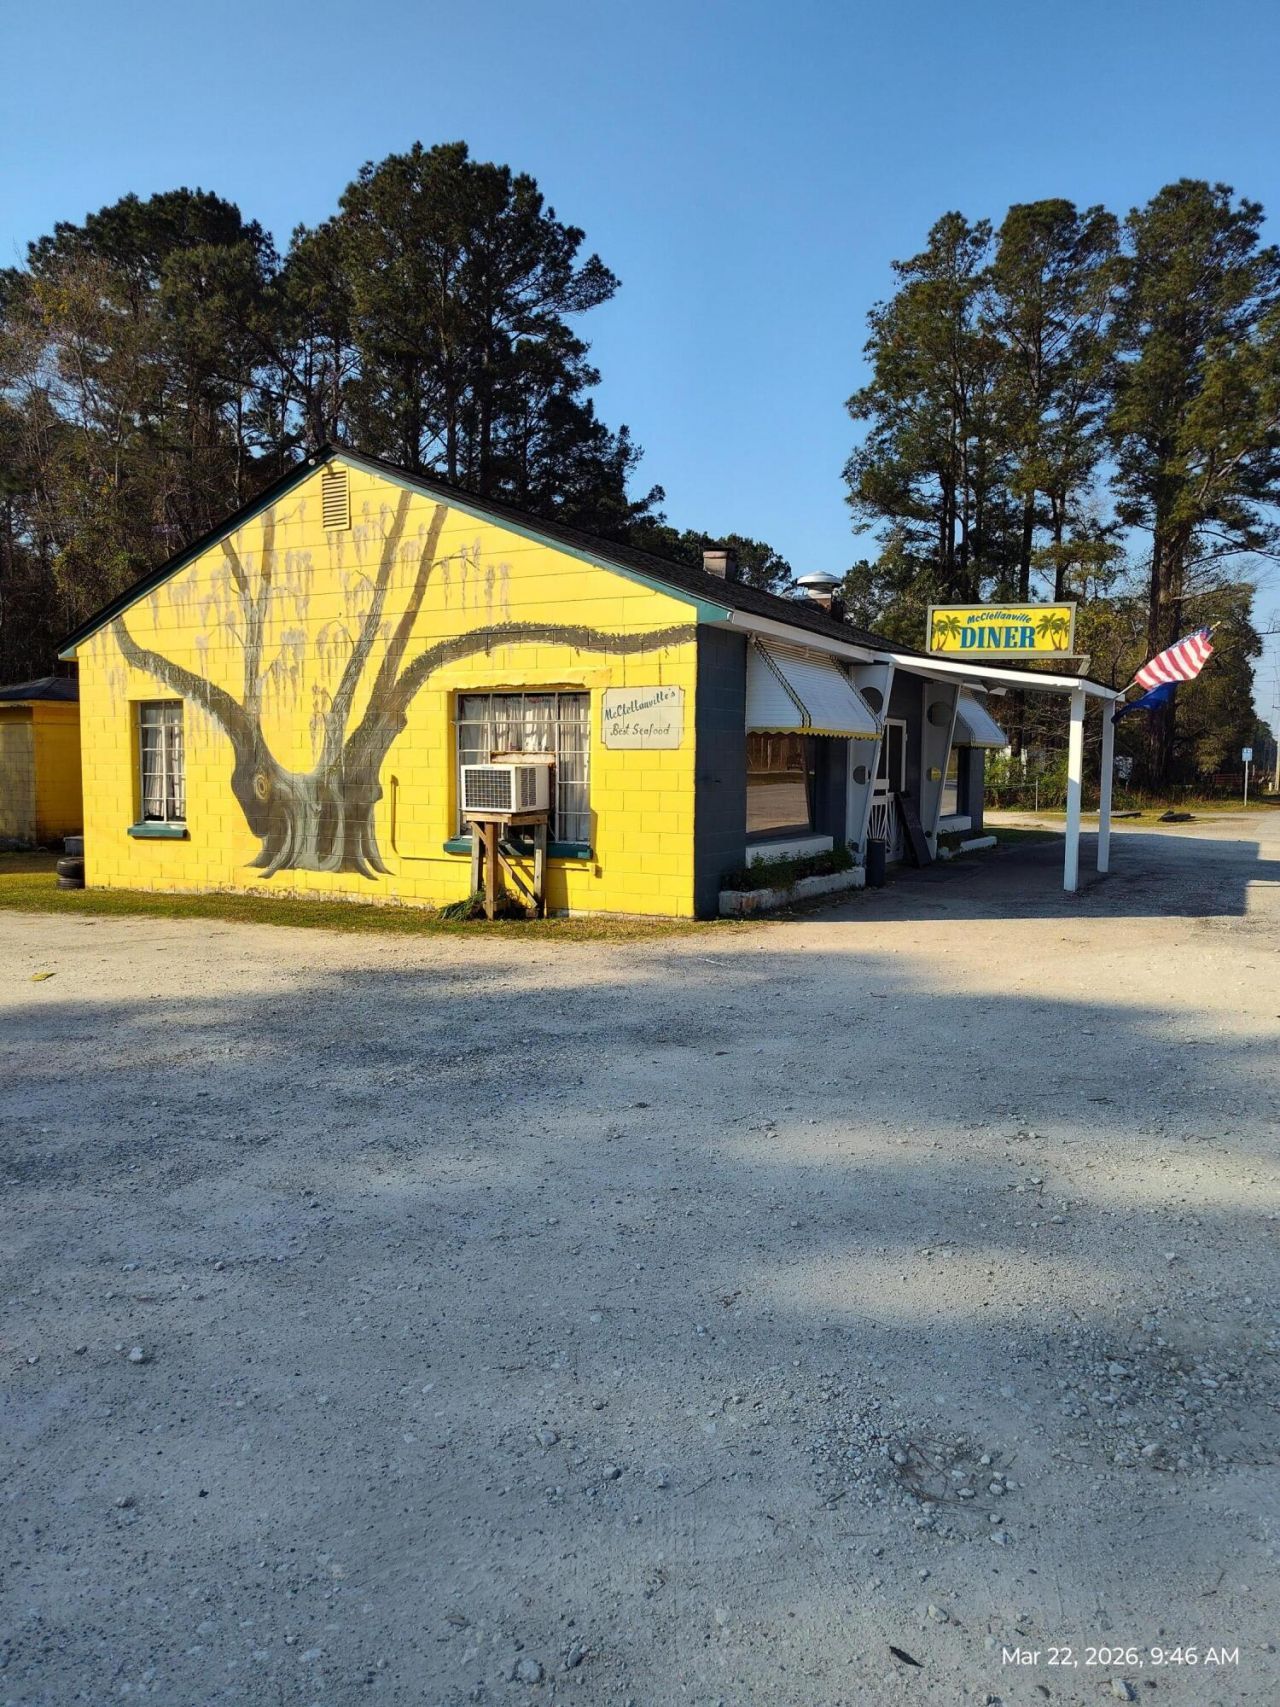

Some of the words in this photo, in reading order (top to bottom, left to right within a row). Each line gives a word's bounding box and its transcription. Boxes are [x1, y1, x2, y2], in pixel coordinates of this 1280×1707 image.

[967, 611, 1032, 624] McClellanville
[960, 626, 1036, 648] DINER
[604, 688, 676, 720] McClellanville's
[610, 723, 630, 735] Best
[632, 723, 671, 737] Seafood
